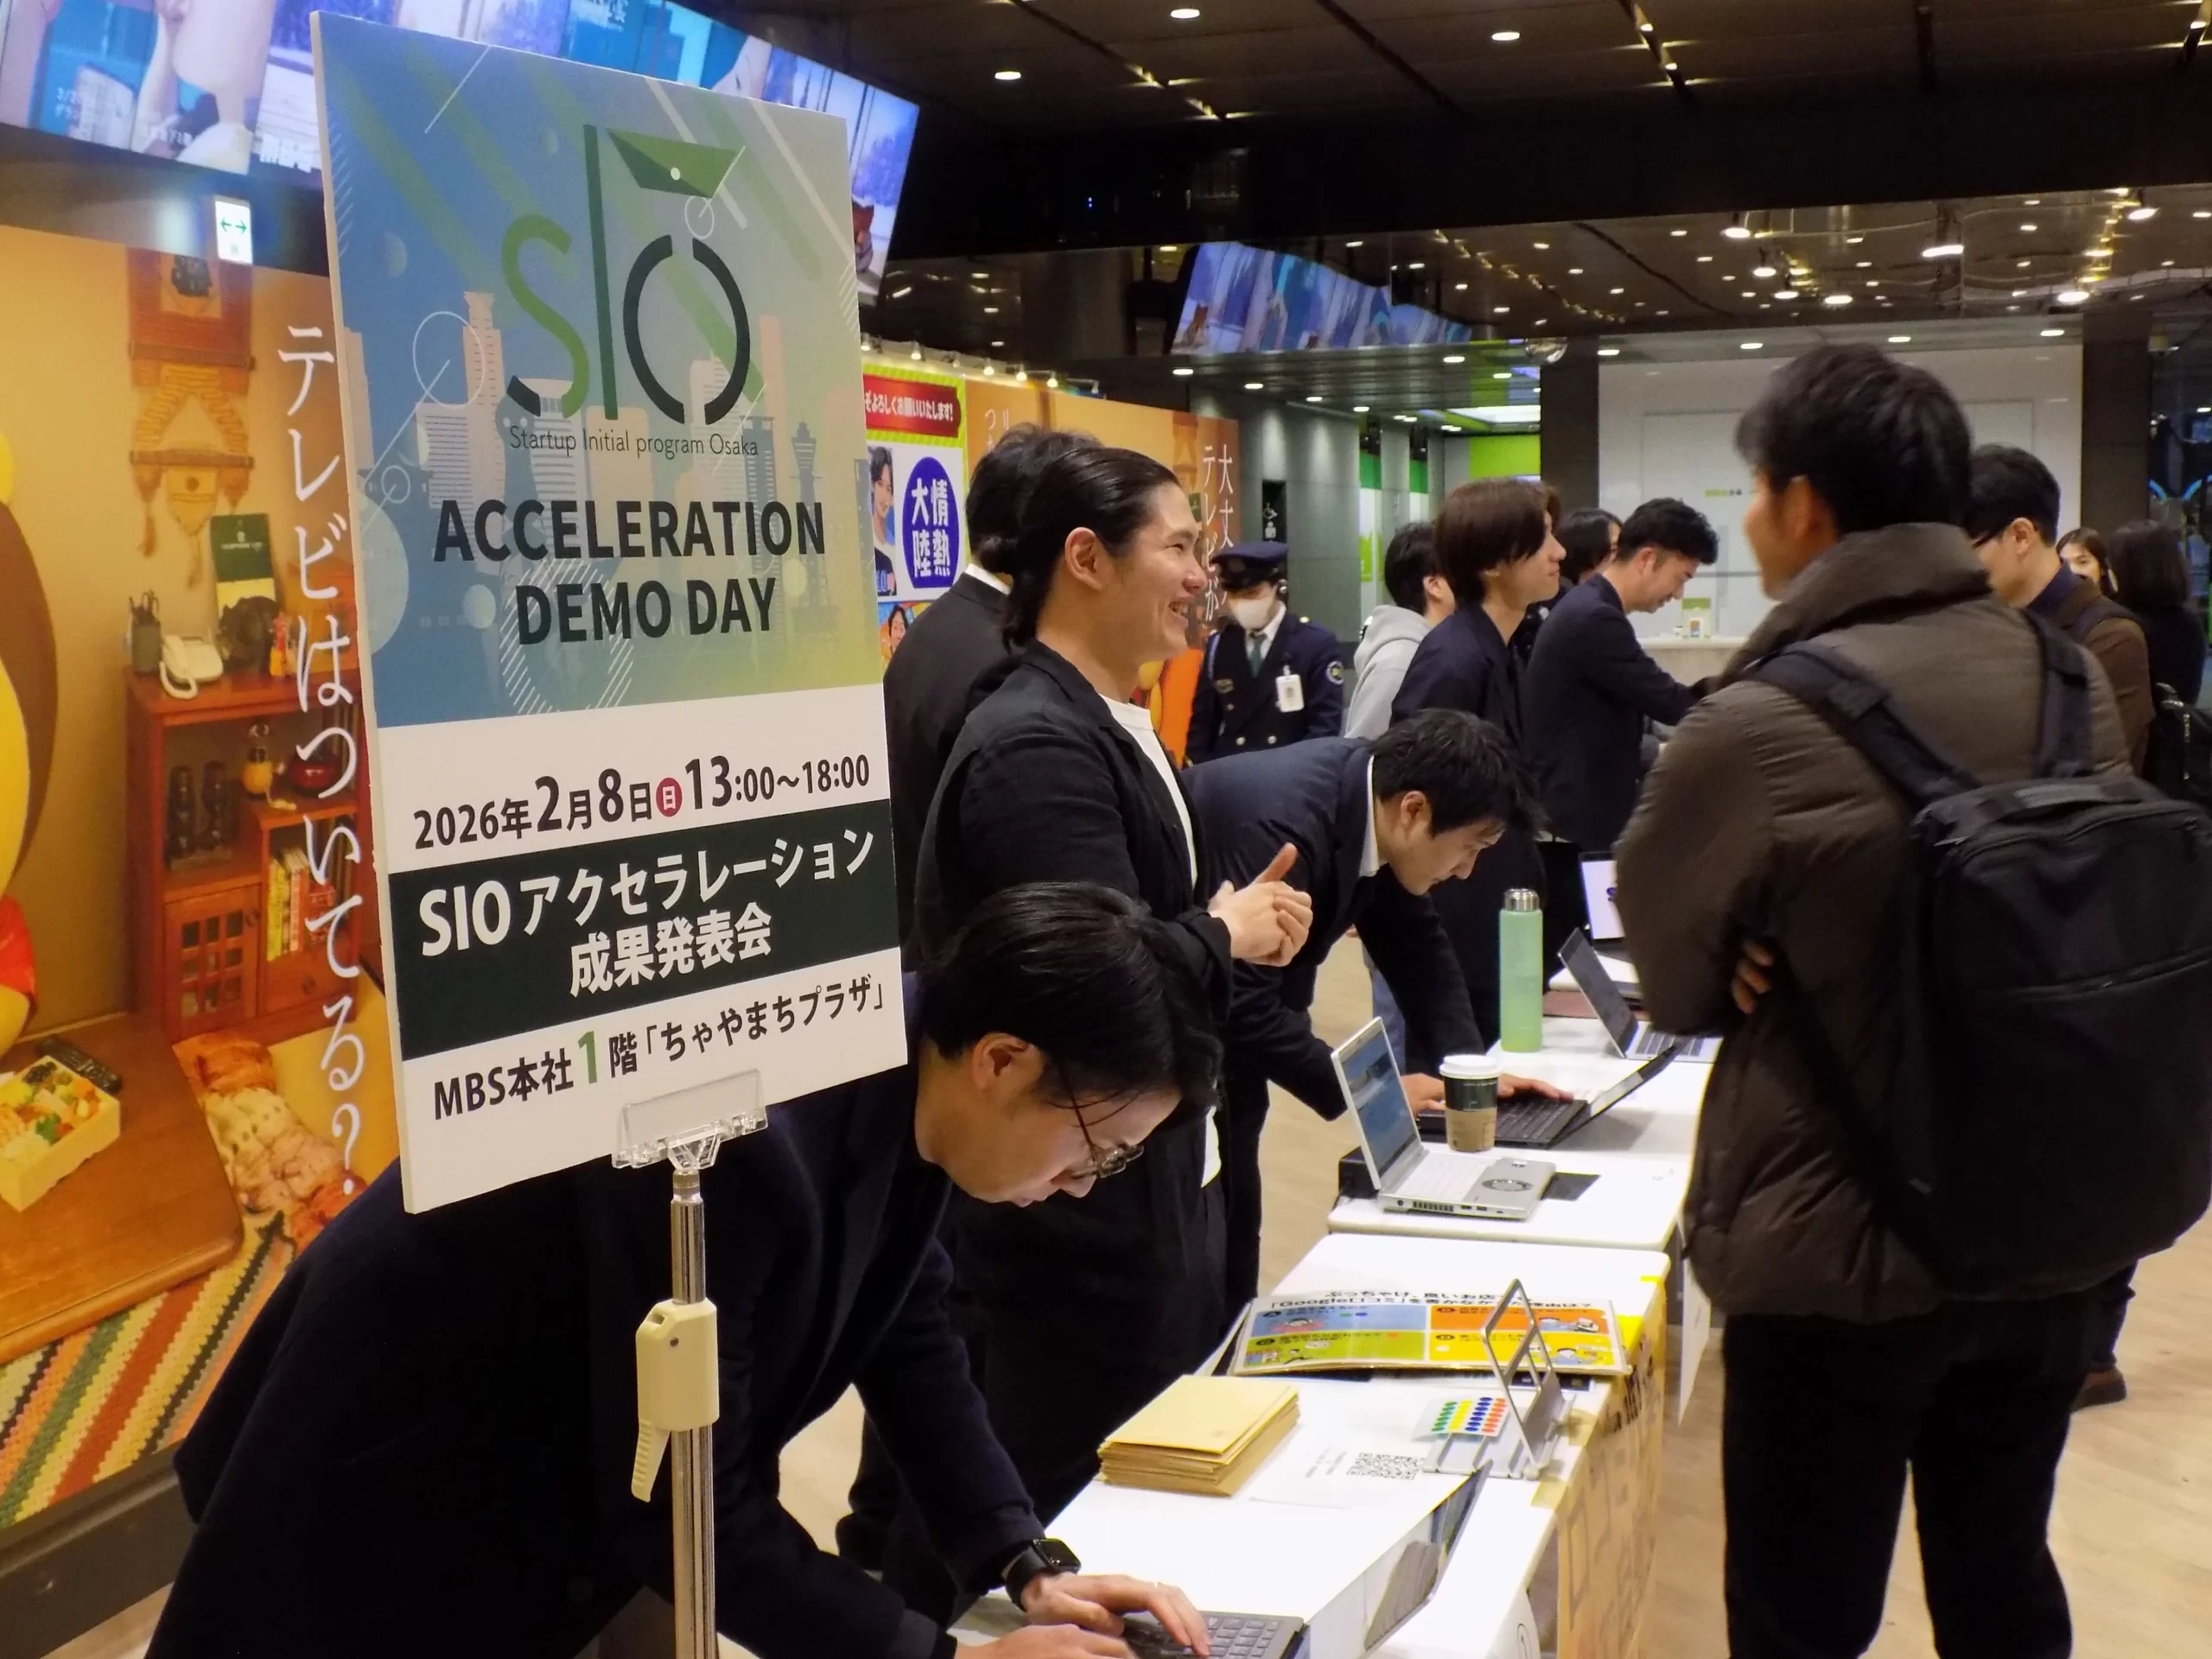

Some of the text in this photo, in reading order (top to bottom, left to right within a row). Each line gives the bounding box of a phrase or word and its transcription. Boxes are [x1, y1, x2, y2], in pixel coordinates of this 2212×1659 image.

[510, 425, 758, 460] Startup Initial program Osaka
[434, 499, 825, 563] ACCELERATION
[516, 577, 777, 645] DEMO DAY
[569, 901, 772, 998] 成果発表会
